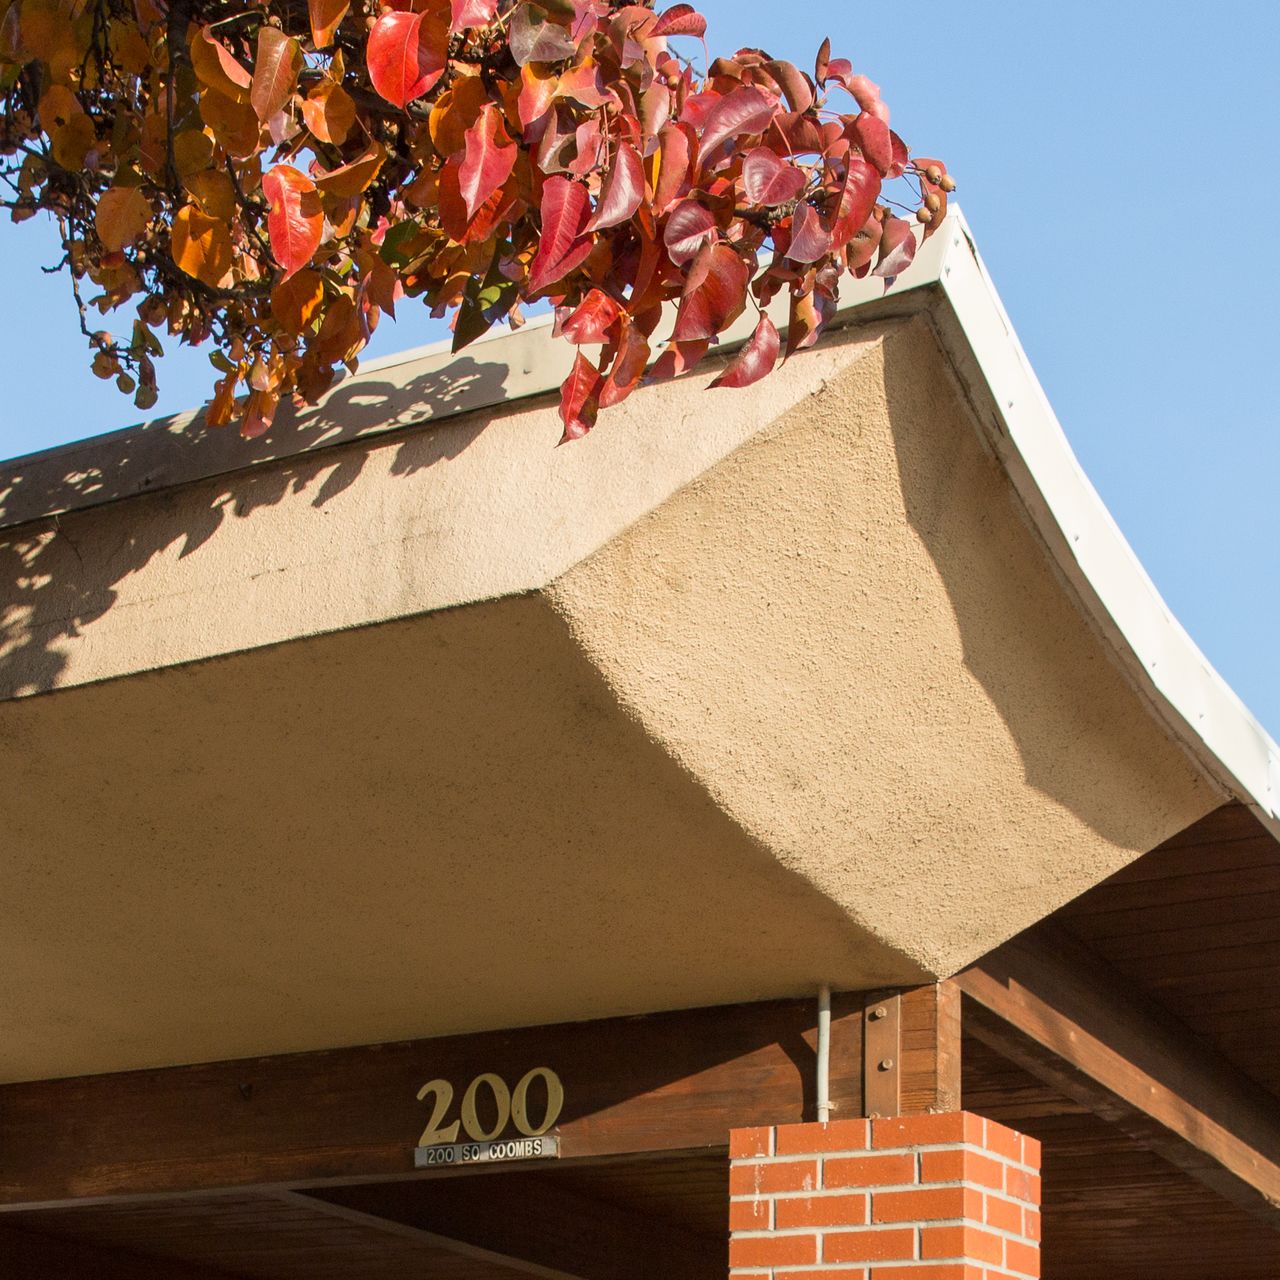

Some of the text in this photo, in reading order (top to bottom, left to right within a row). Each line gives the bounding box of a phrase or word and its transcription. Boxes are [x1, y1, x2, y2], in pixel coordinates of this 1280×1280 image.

[416, 1066, 564, 1147] 200
[427, 1140, 542, 1164] 200 SO COOMBS
